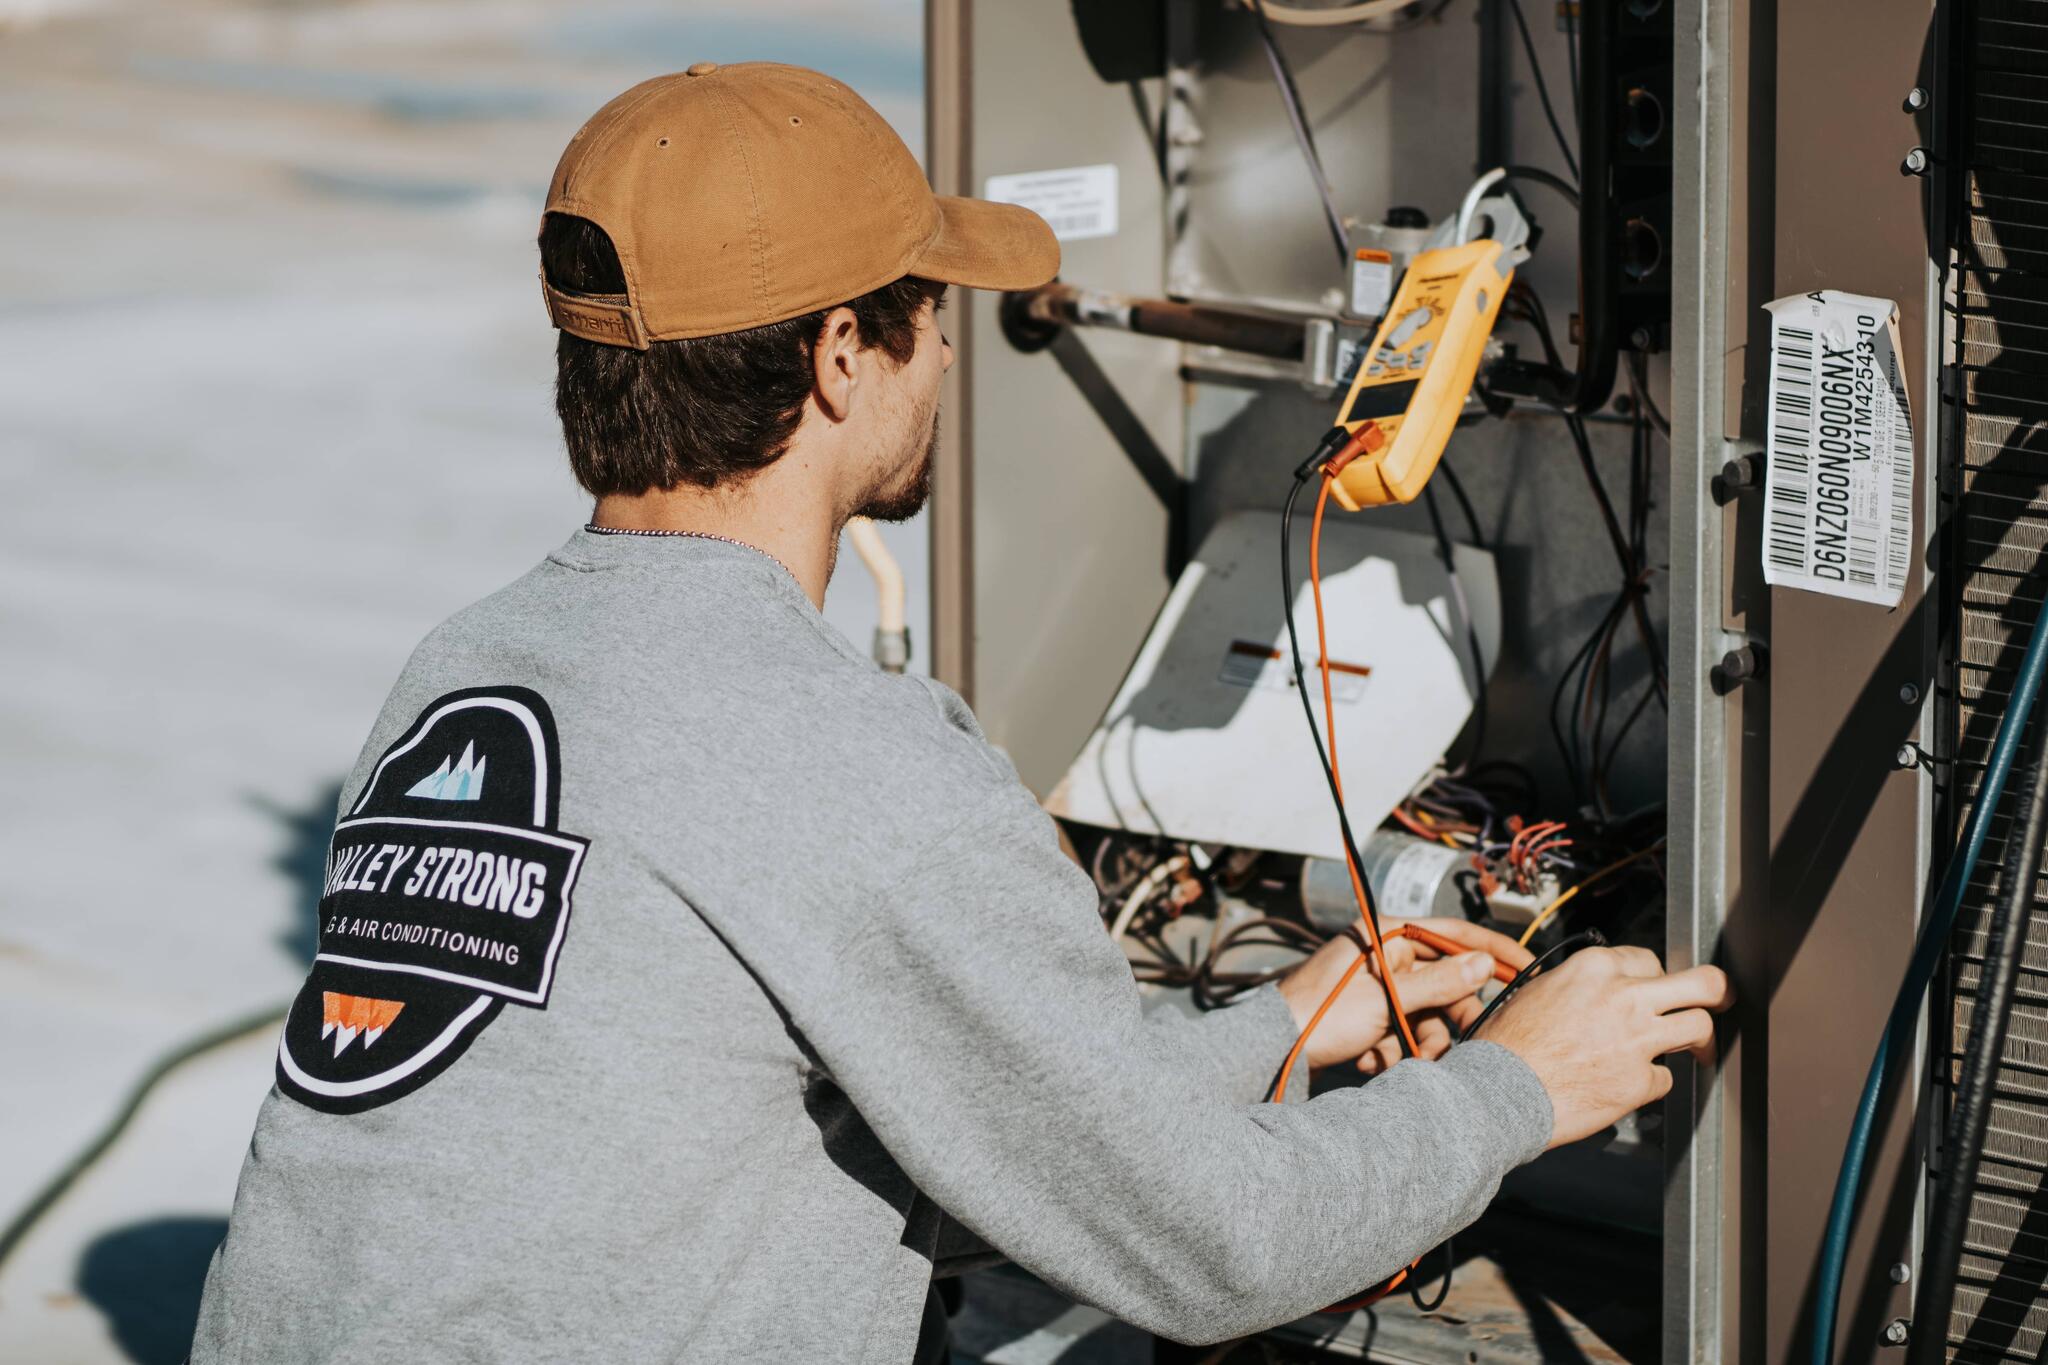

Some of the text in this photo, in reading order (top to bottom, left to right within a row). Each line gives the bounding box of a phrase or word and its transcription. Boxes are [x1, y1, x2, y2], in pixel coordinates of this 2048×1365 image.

[1853, 315, 1875, 461] W1M4254310
[1876, 400, 1886, 418] SEER
[1813, 345, 1854, 582] D6NZ060N09006NX
[404, 847, 547, 918] STRONG
[338, 917, 348, 934] &
[349, 918, 379, 938] AIR
[381, 922, 519, 965] CONDITIONING
